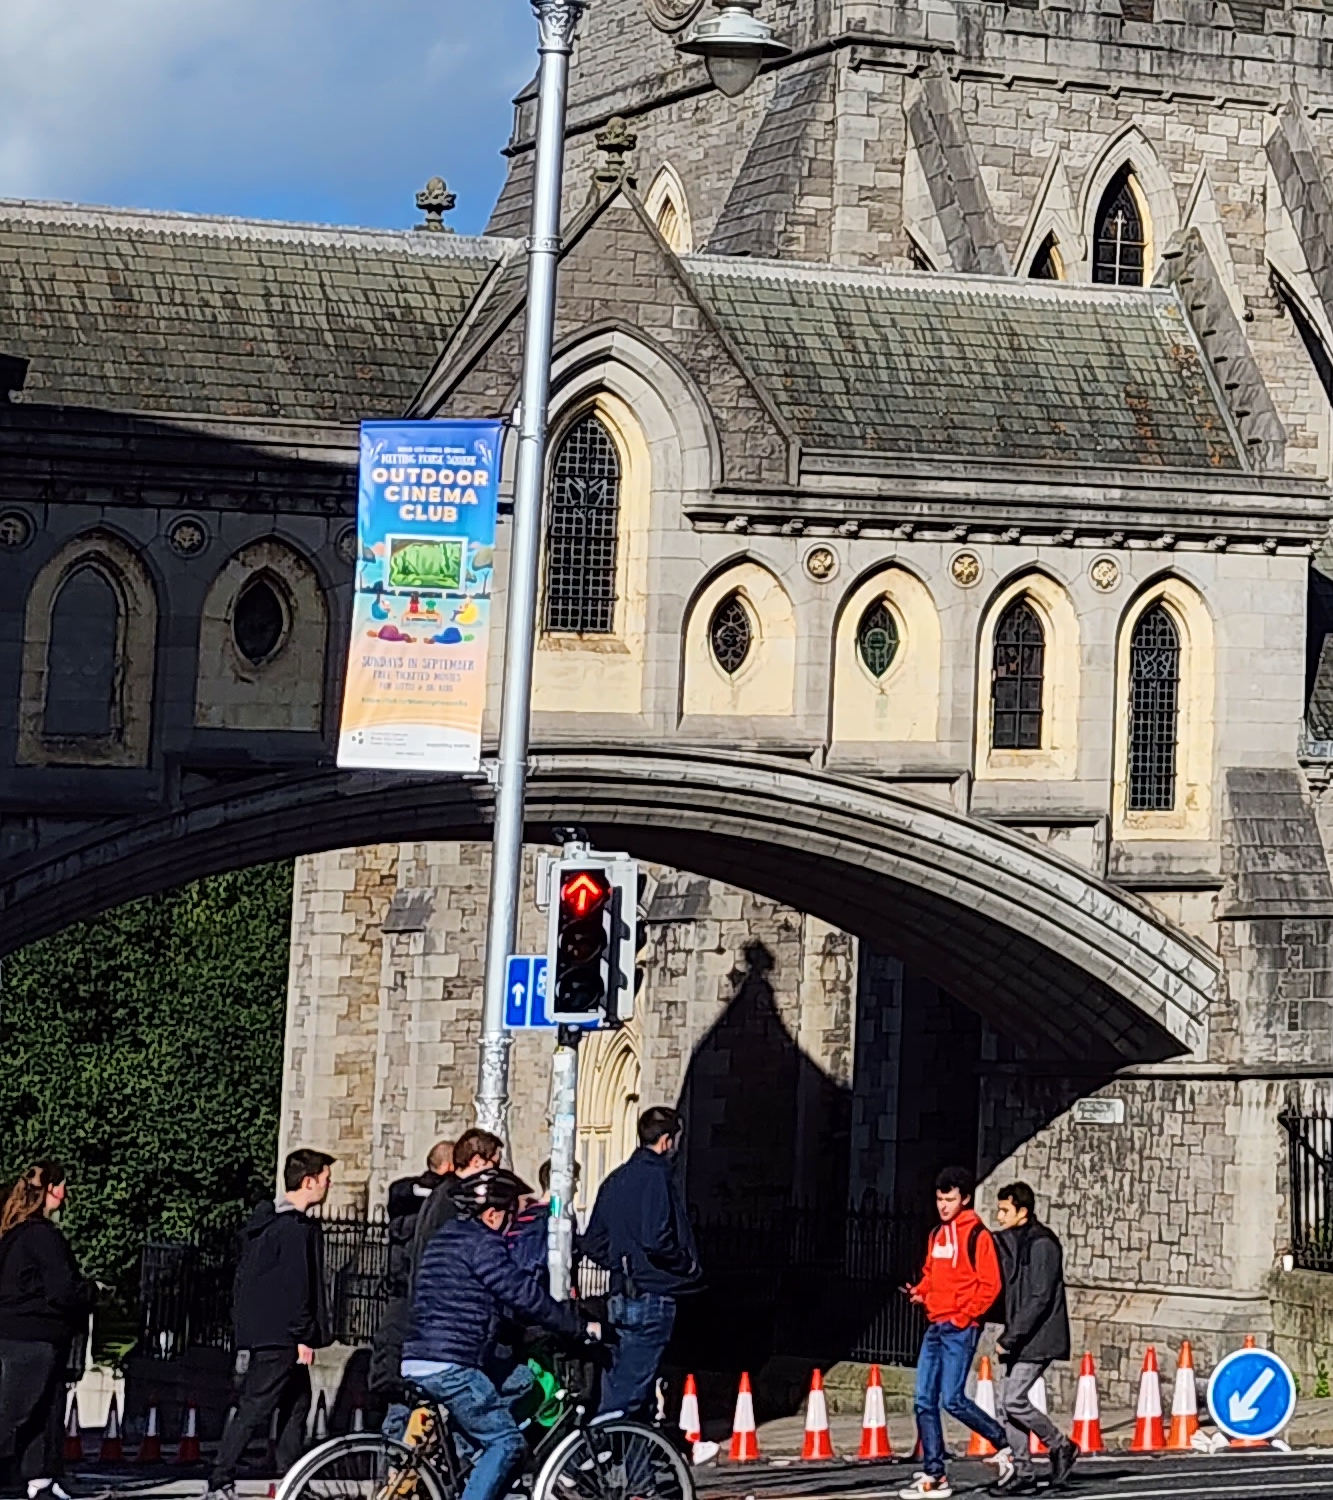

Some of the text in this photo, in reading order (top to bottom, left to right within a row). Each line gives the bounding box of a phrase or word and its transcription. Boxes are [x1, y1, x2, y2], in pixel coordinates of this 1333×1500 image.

[372, 467, 488, 486] OUTDOOR
[384, 486, 478, 504] CINEMA
[399, 504, 458, 522] CLUB
[362, 656, 474, 670] SUNDAYS IN SEPTEMBER
